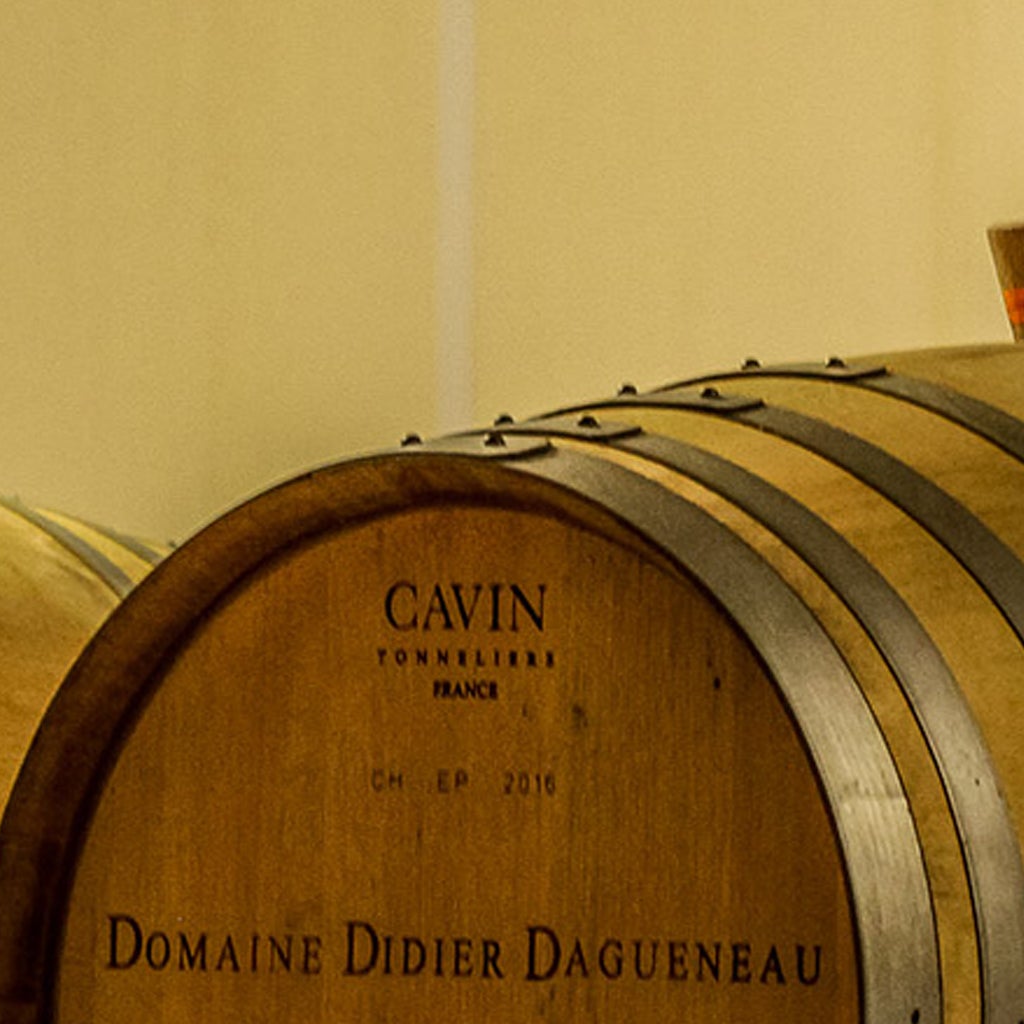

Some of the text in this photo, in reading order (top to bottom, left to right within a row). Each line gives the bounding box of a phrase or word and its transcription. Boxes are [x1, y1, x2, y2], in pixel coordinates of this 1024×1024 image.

[384, 580, 547, 632] CAVIN
[433, 680, 499, 699] FRANCE
[503, 771, 556, 796] 2016
[105, 914, 823, 986] DOMAINE DIDIER DAGUENEAU
